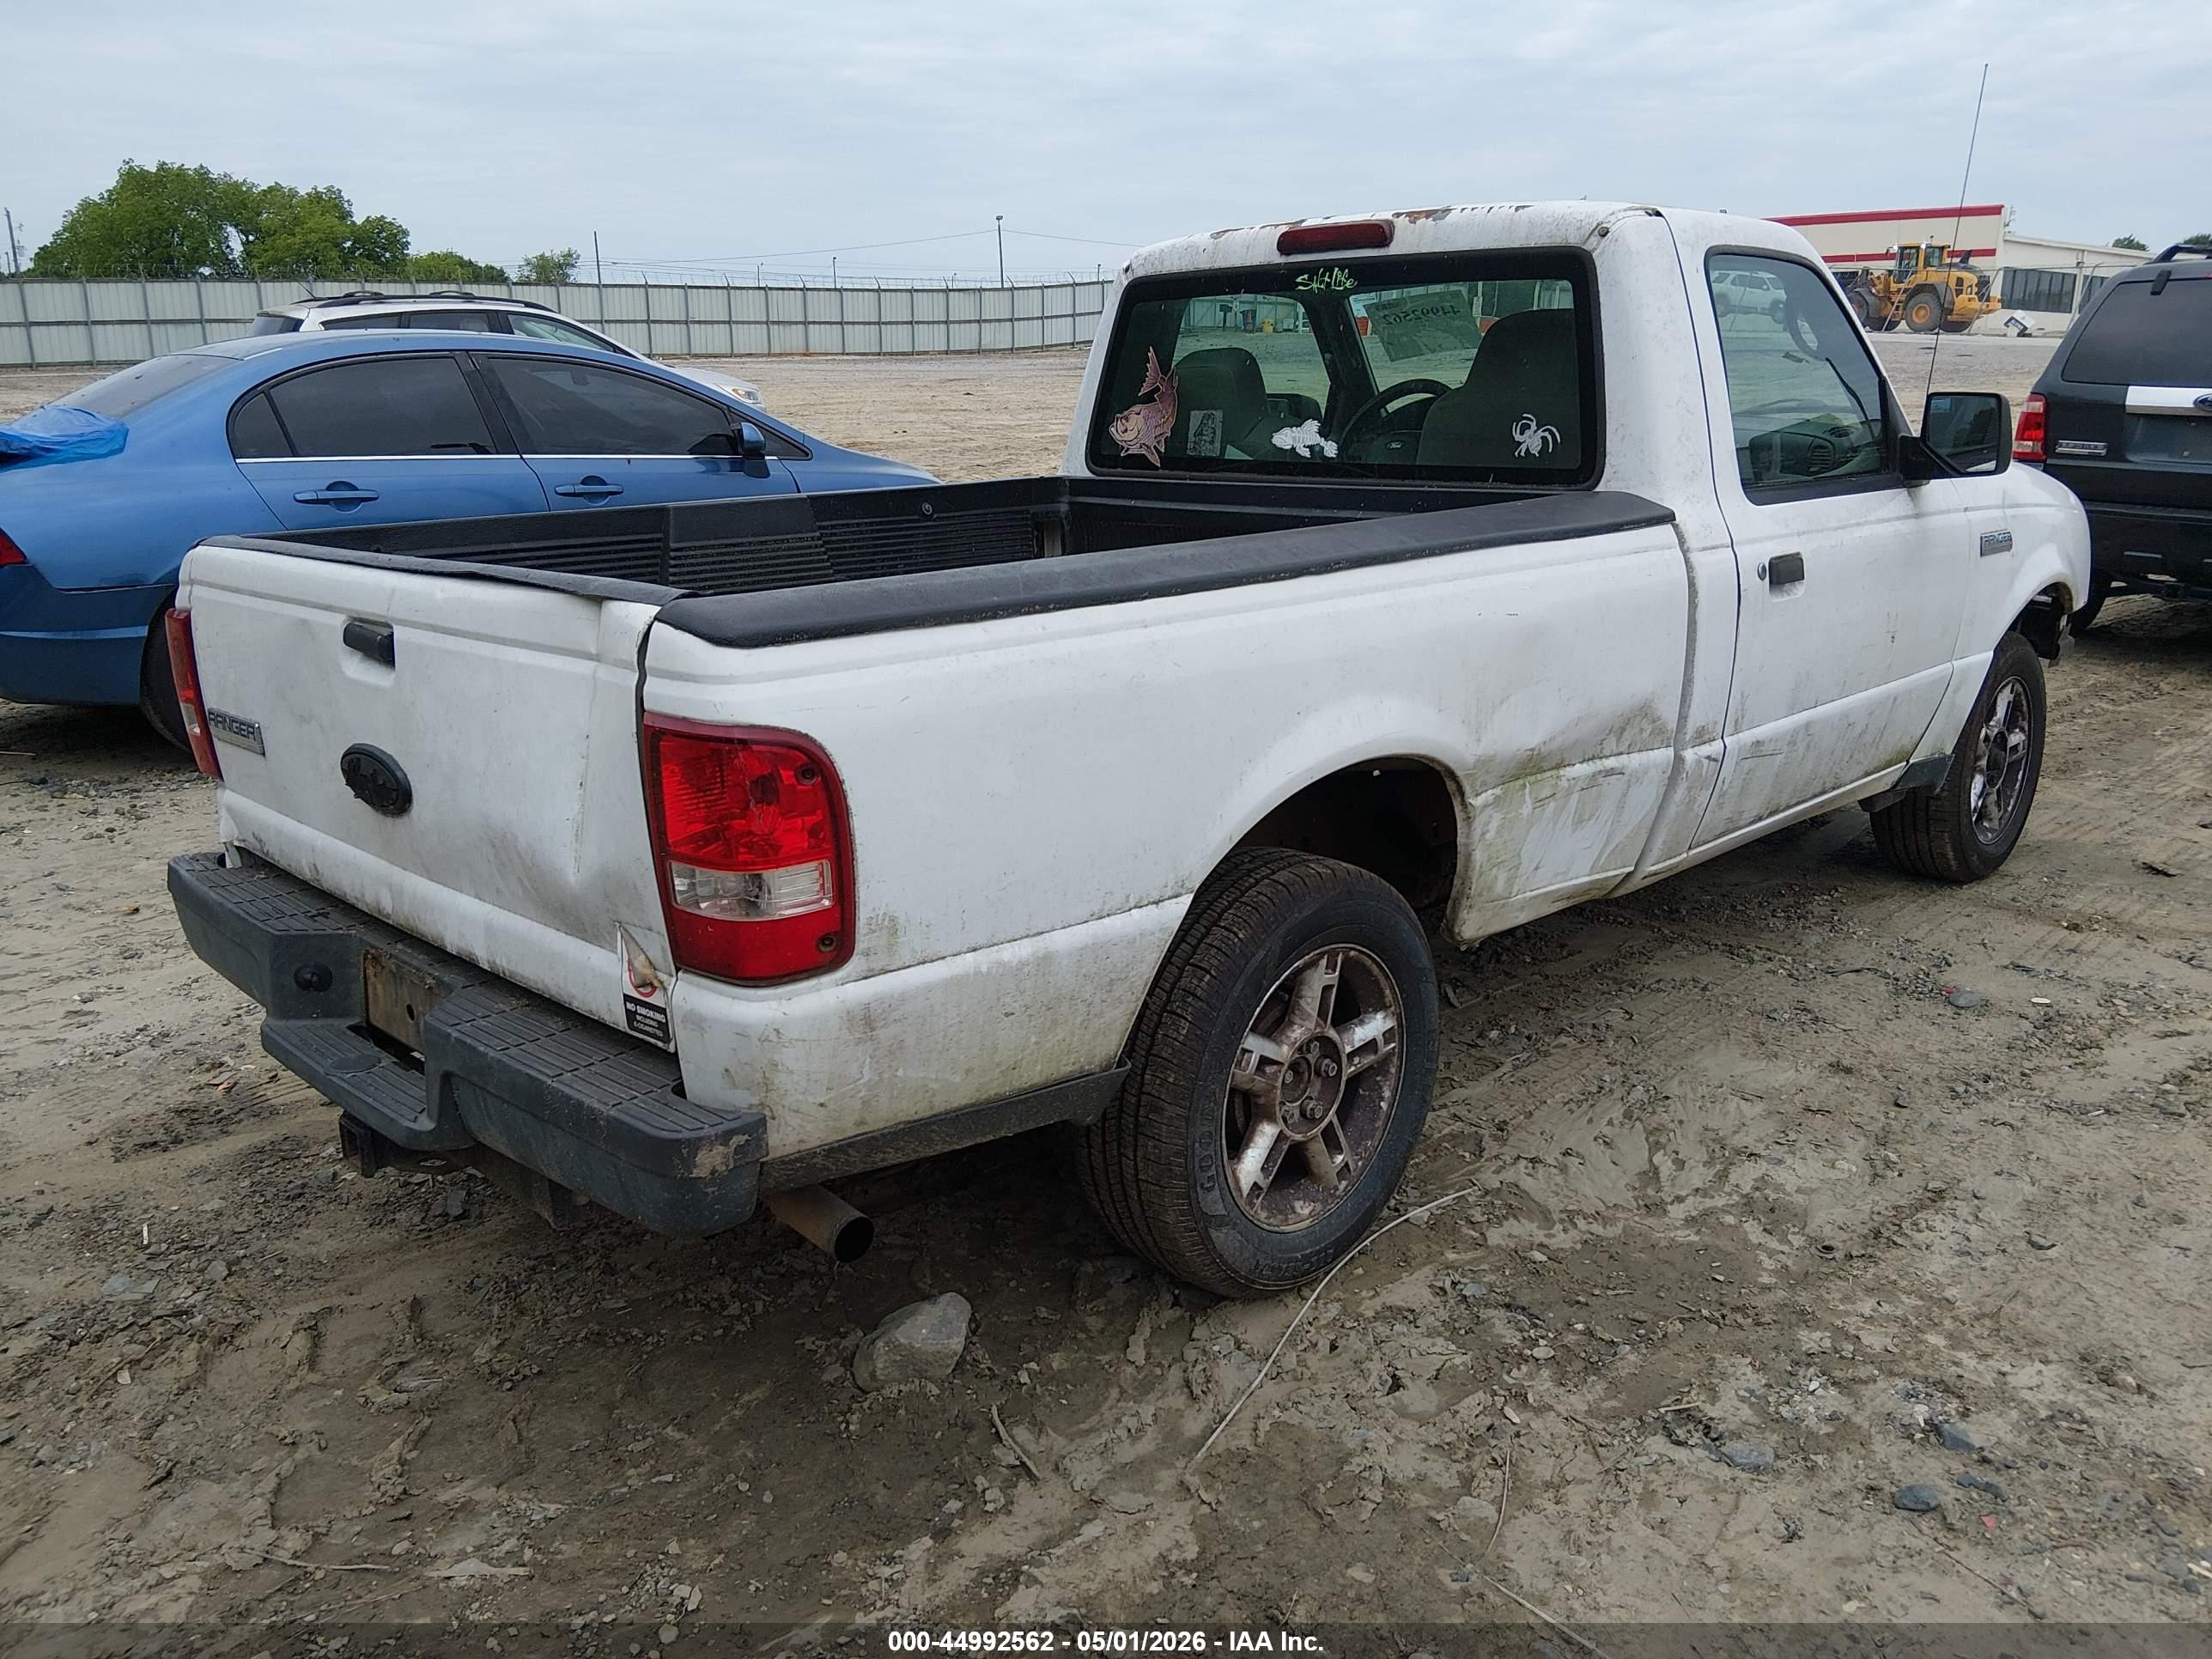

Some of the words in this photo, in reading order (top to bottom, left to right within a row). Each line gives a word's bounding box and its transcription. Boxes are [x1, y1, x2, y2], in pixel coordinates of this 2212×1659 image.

[208, 711, 256, 742] RANGER
[626, 1001, 635, 1012] NO
[636, 1005, 666, 1024] SMOKING
